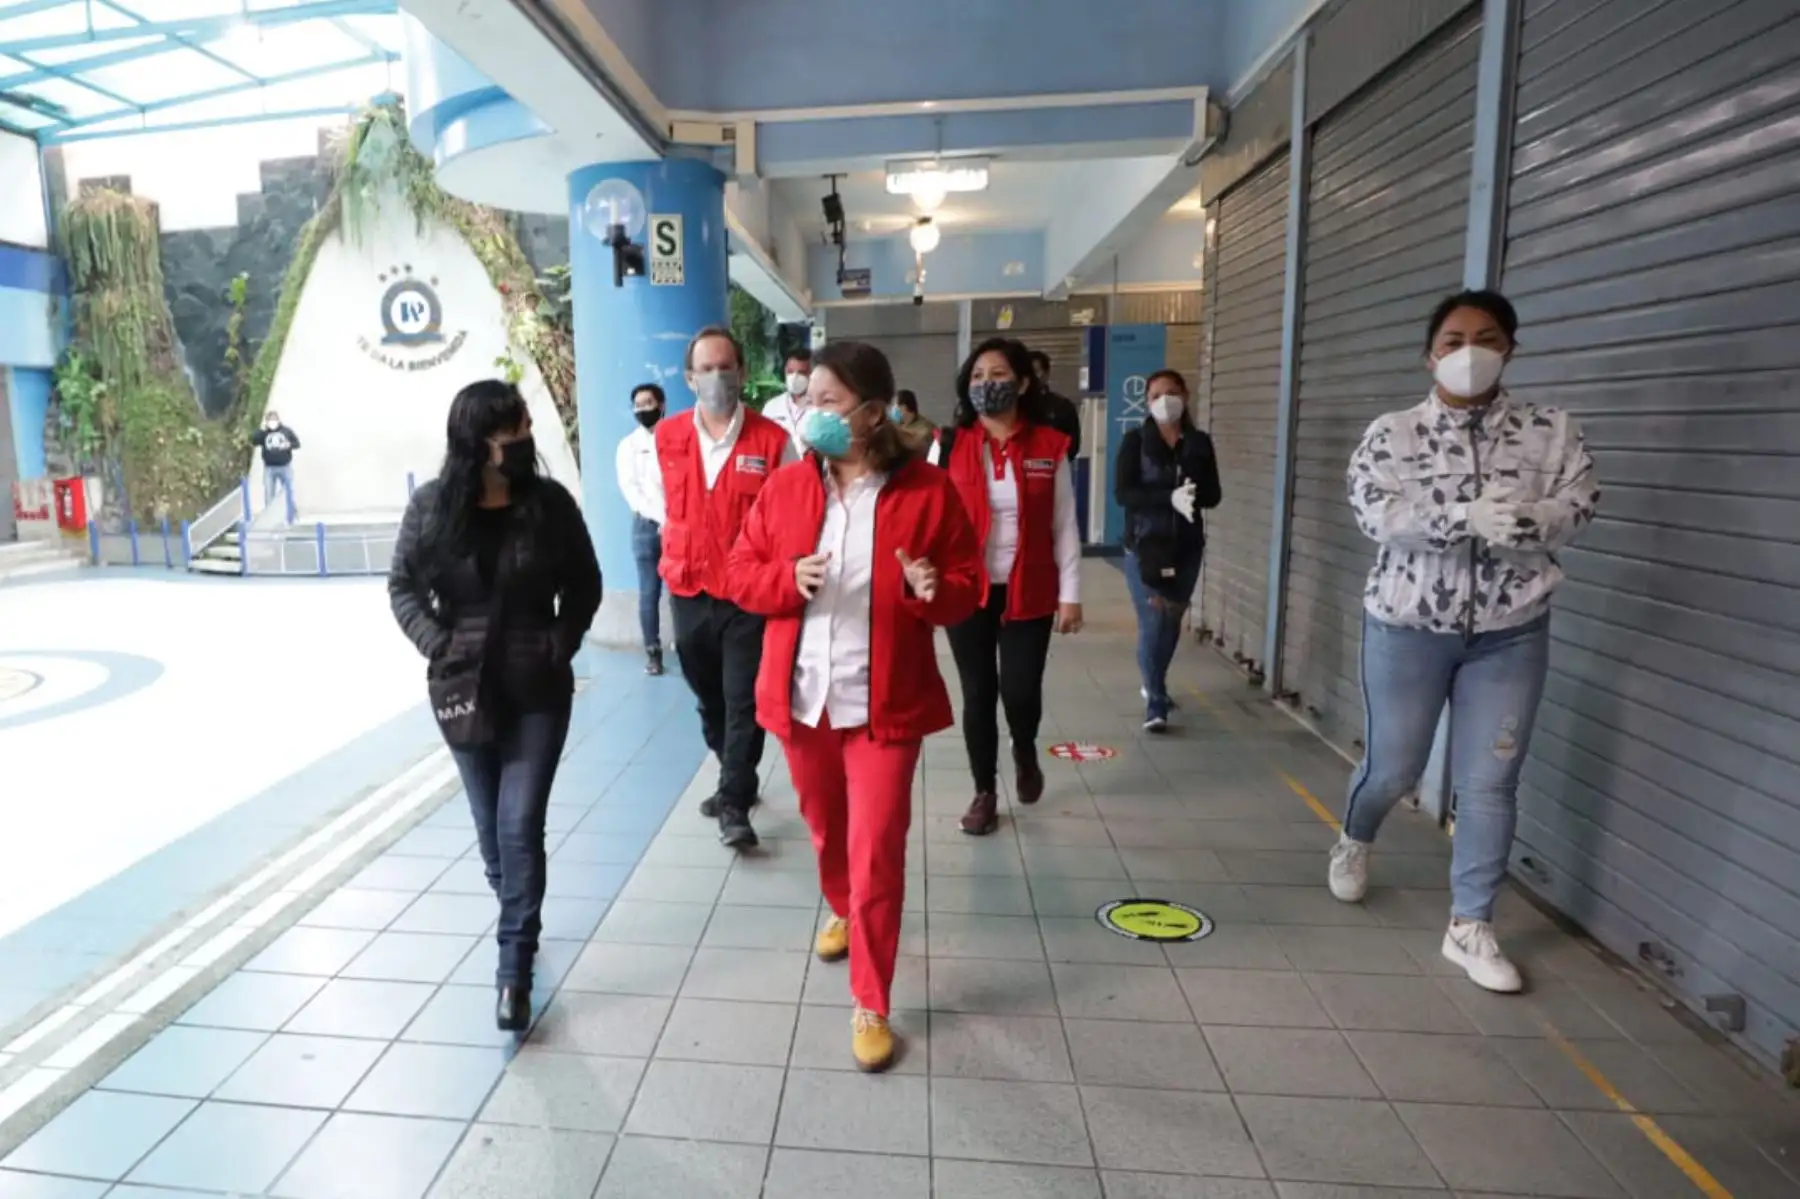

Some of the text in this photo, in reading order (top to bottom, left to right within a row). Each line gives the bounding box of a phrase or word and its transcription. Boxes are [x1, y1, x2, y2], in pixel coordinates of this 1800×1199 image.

[656, 220, 677, 256] S
[388, 357, 405, 370] LA
[437, 700, 476, 720] MAX
